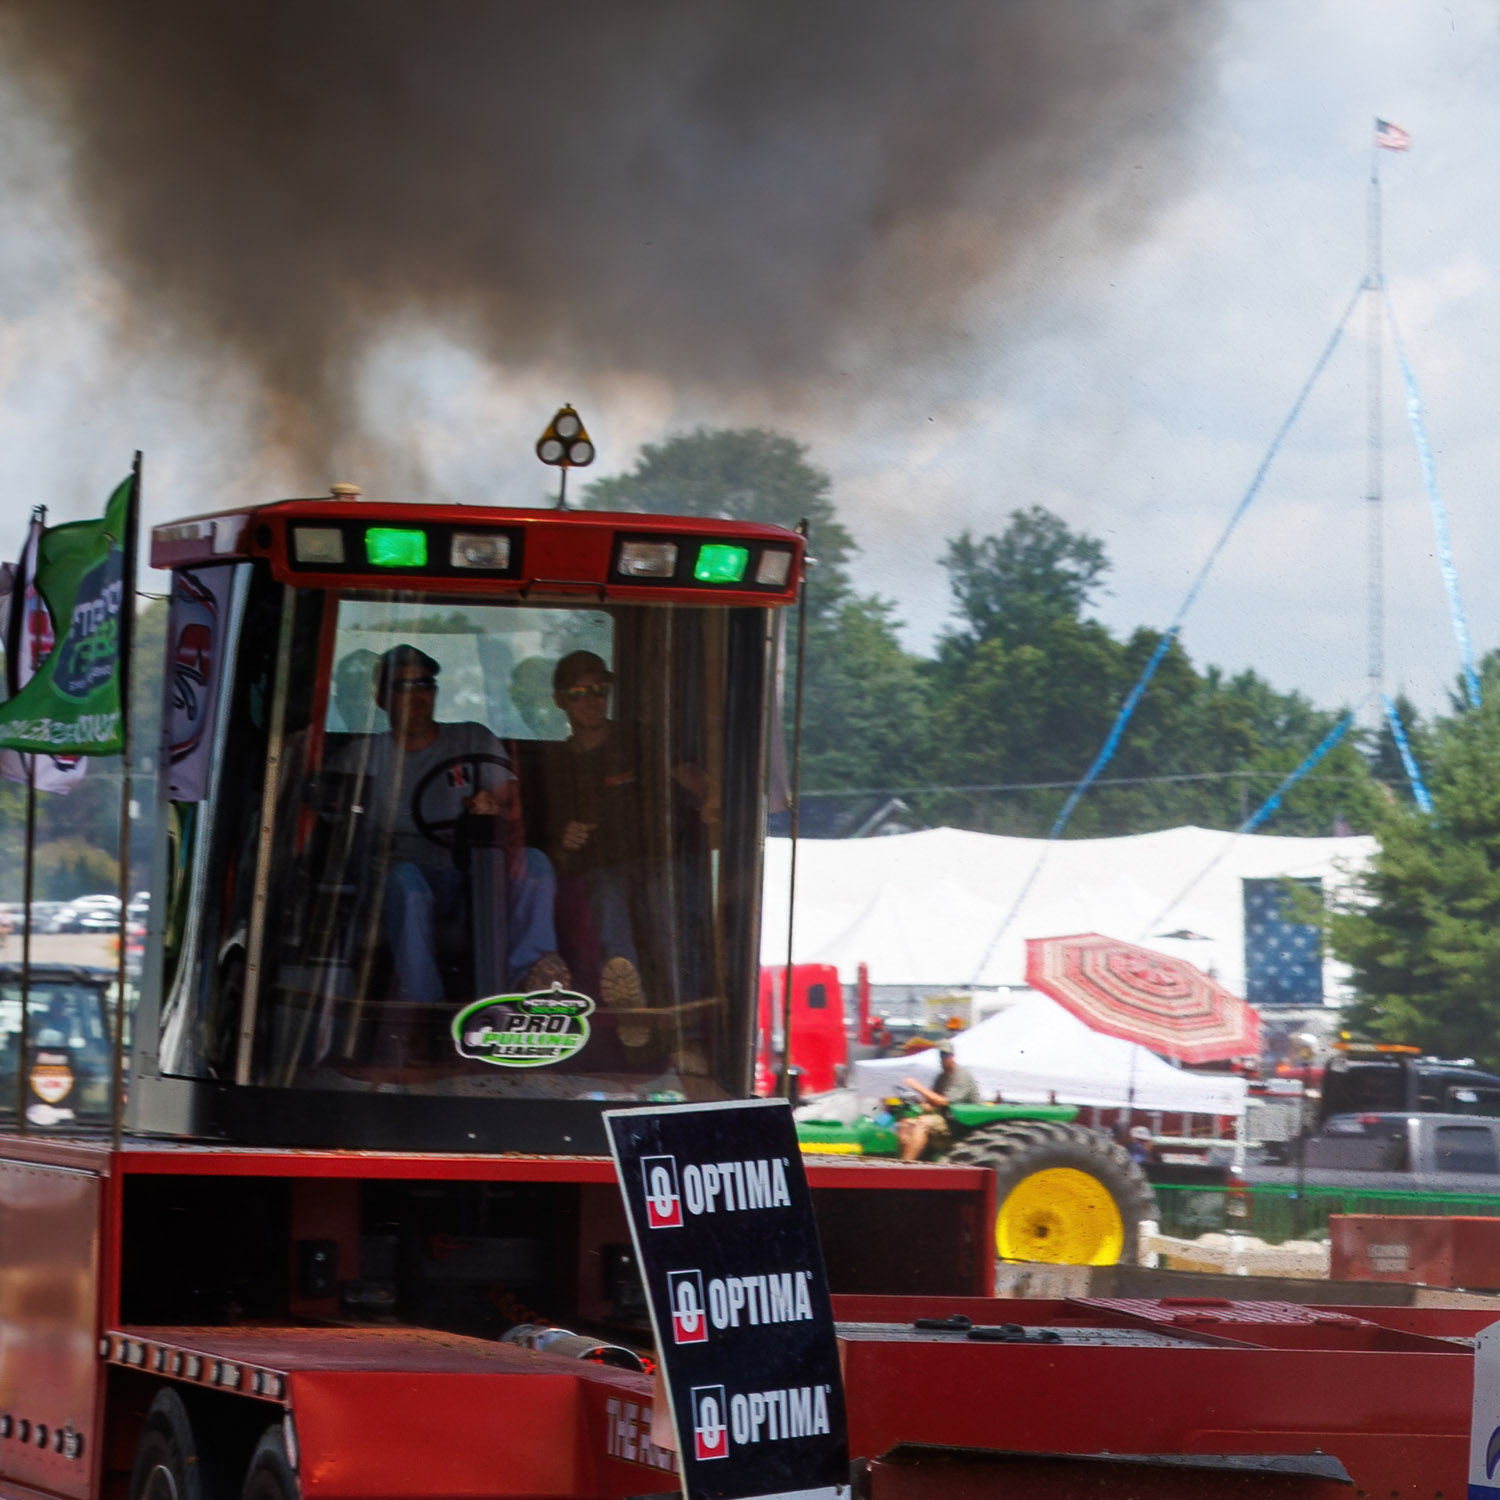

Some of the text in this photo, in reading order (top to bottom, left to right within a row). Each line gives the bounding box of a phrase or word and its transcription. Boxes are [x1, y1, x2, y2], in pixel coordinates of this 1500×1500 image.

[482, 1031, 584, 1049] PULLING
[506, 1014, 572, 1034] PRO
[683, 1158, 792, 1215] OPTIMA
[709, 1272, 813, 1330] OPTIMA
[731, 1386, 830, 1445] OPTIMA
